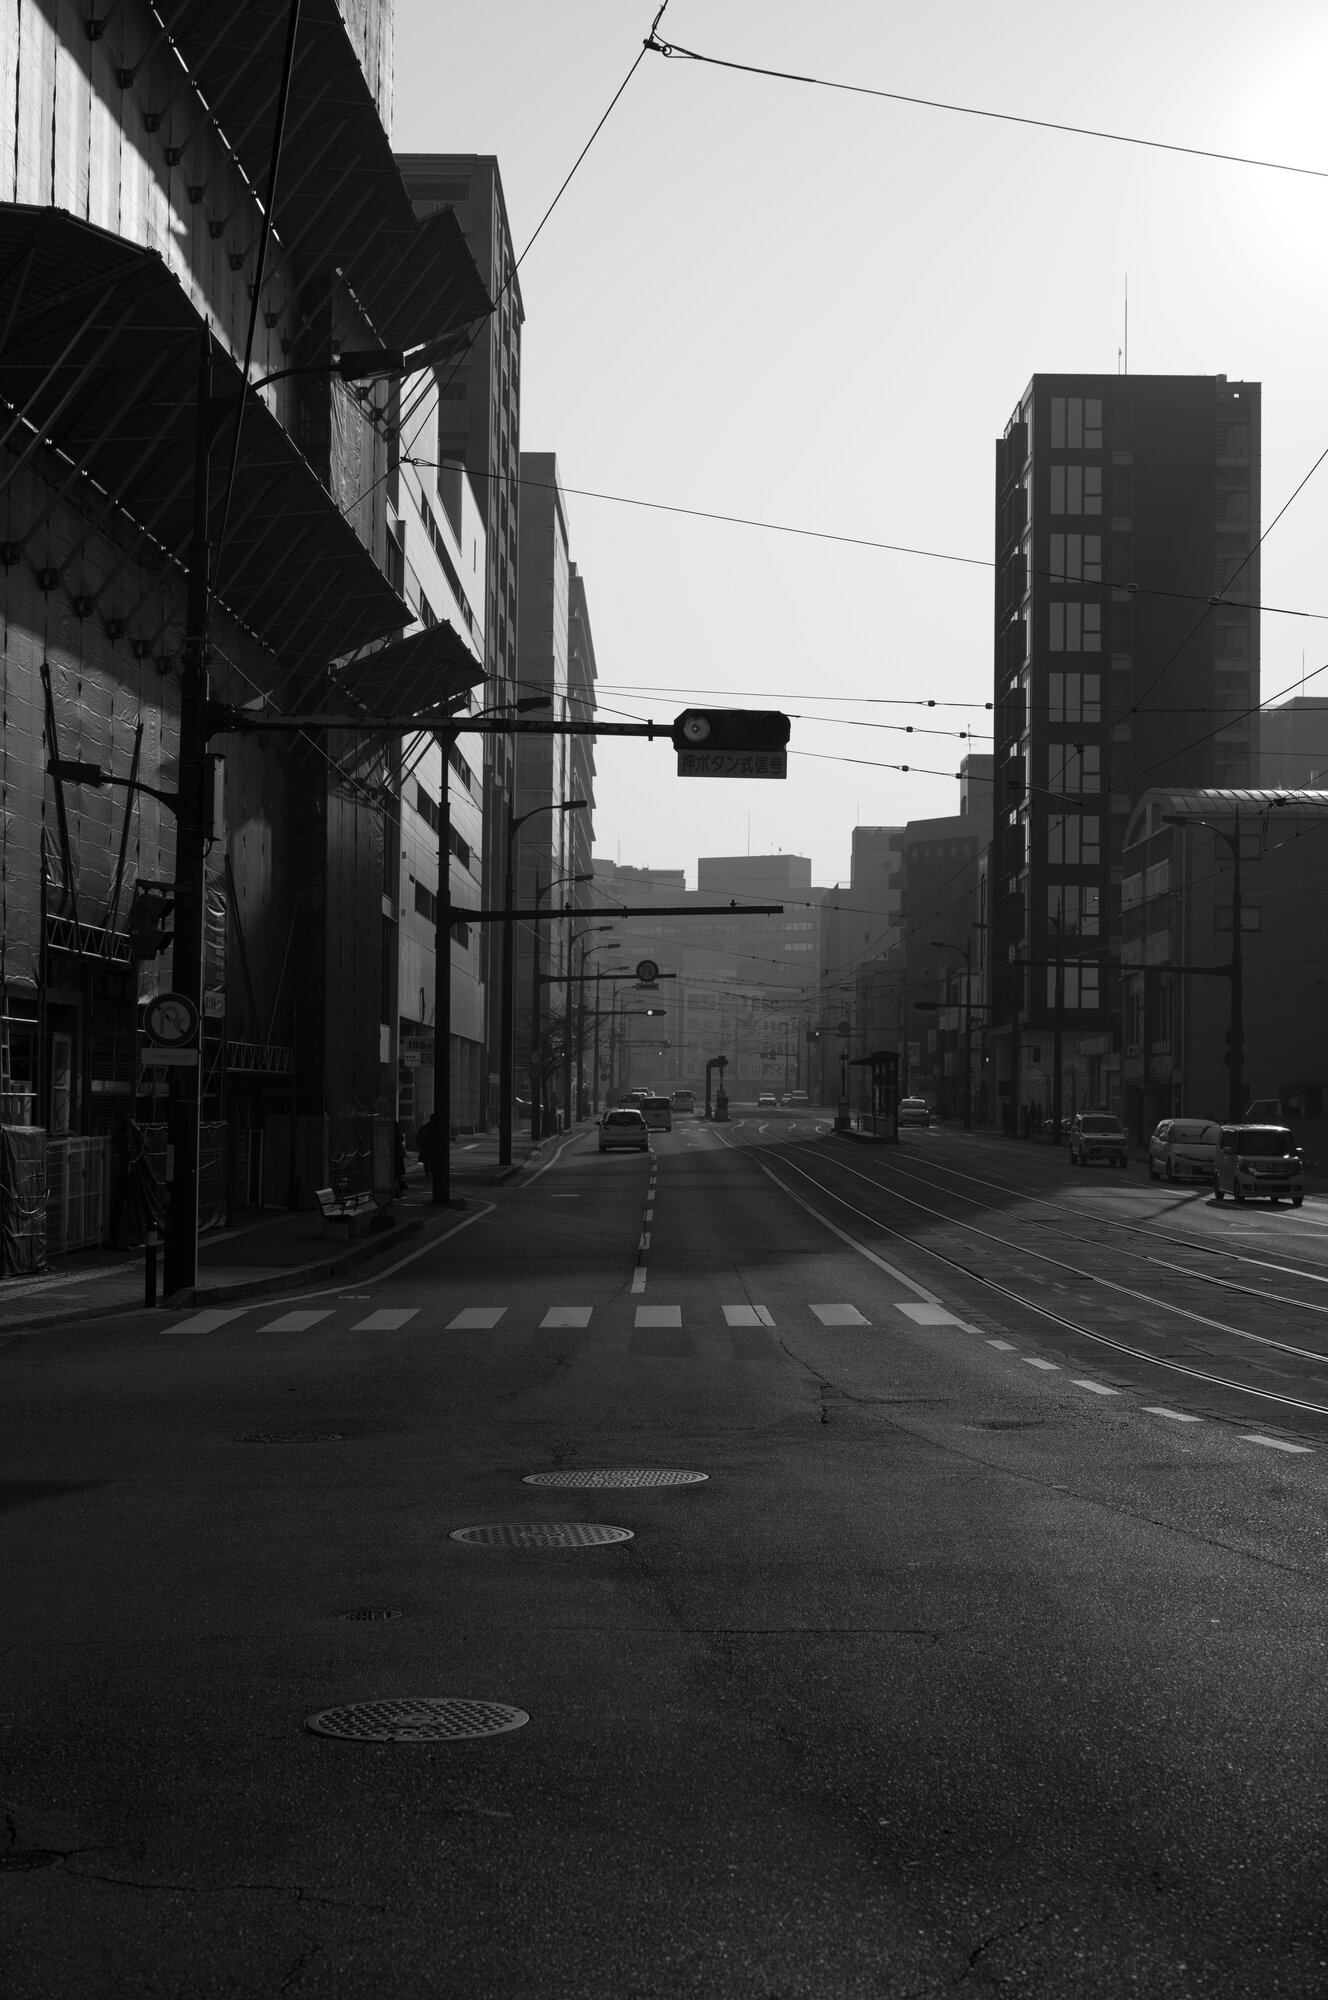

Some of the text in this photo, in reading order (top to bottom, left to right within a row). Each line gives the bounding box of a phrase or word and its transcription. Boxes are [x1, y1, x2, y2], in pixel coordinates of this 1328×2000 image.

[682, 755, 783, 774] 押ボタン式信号
